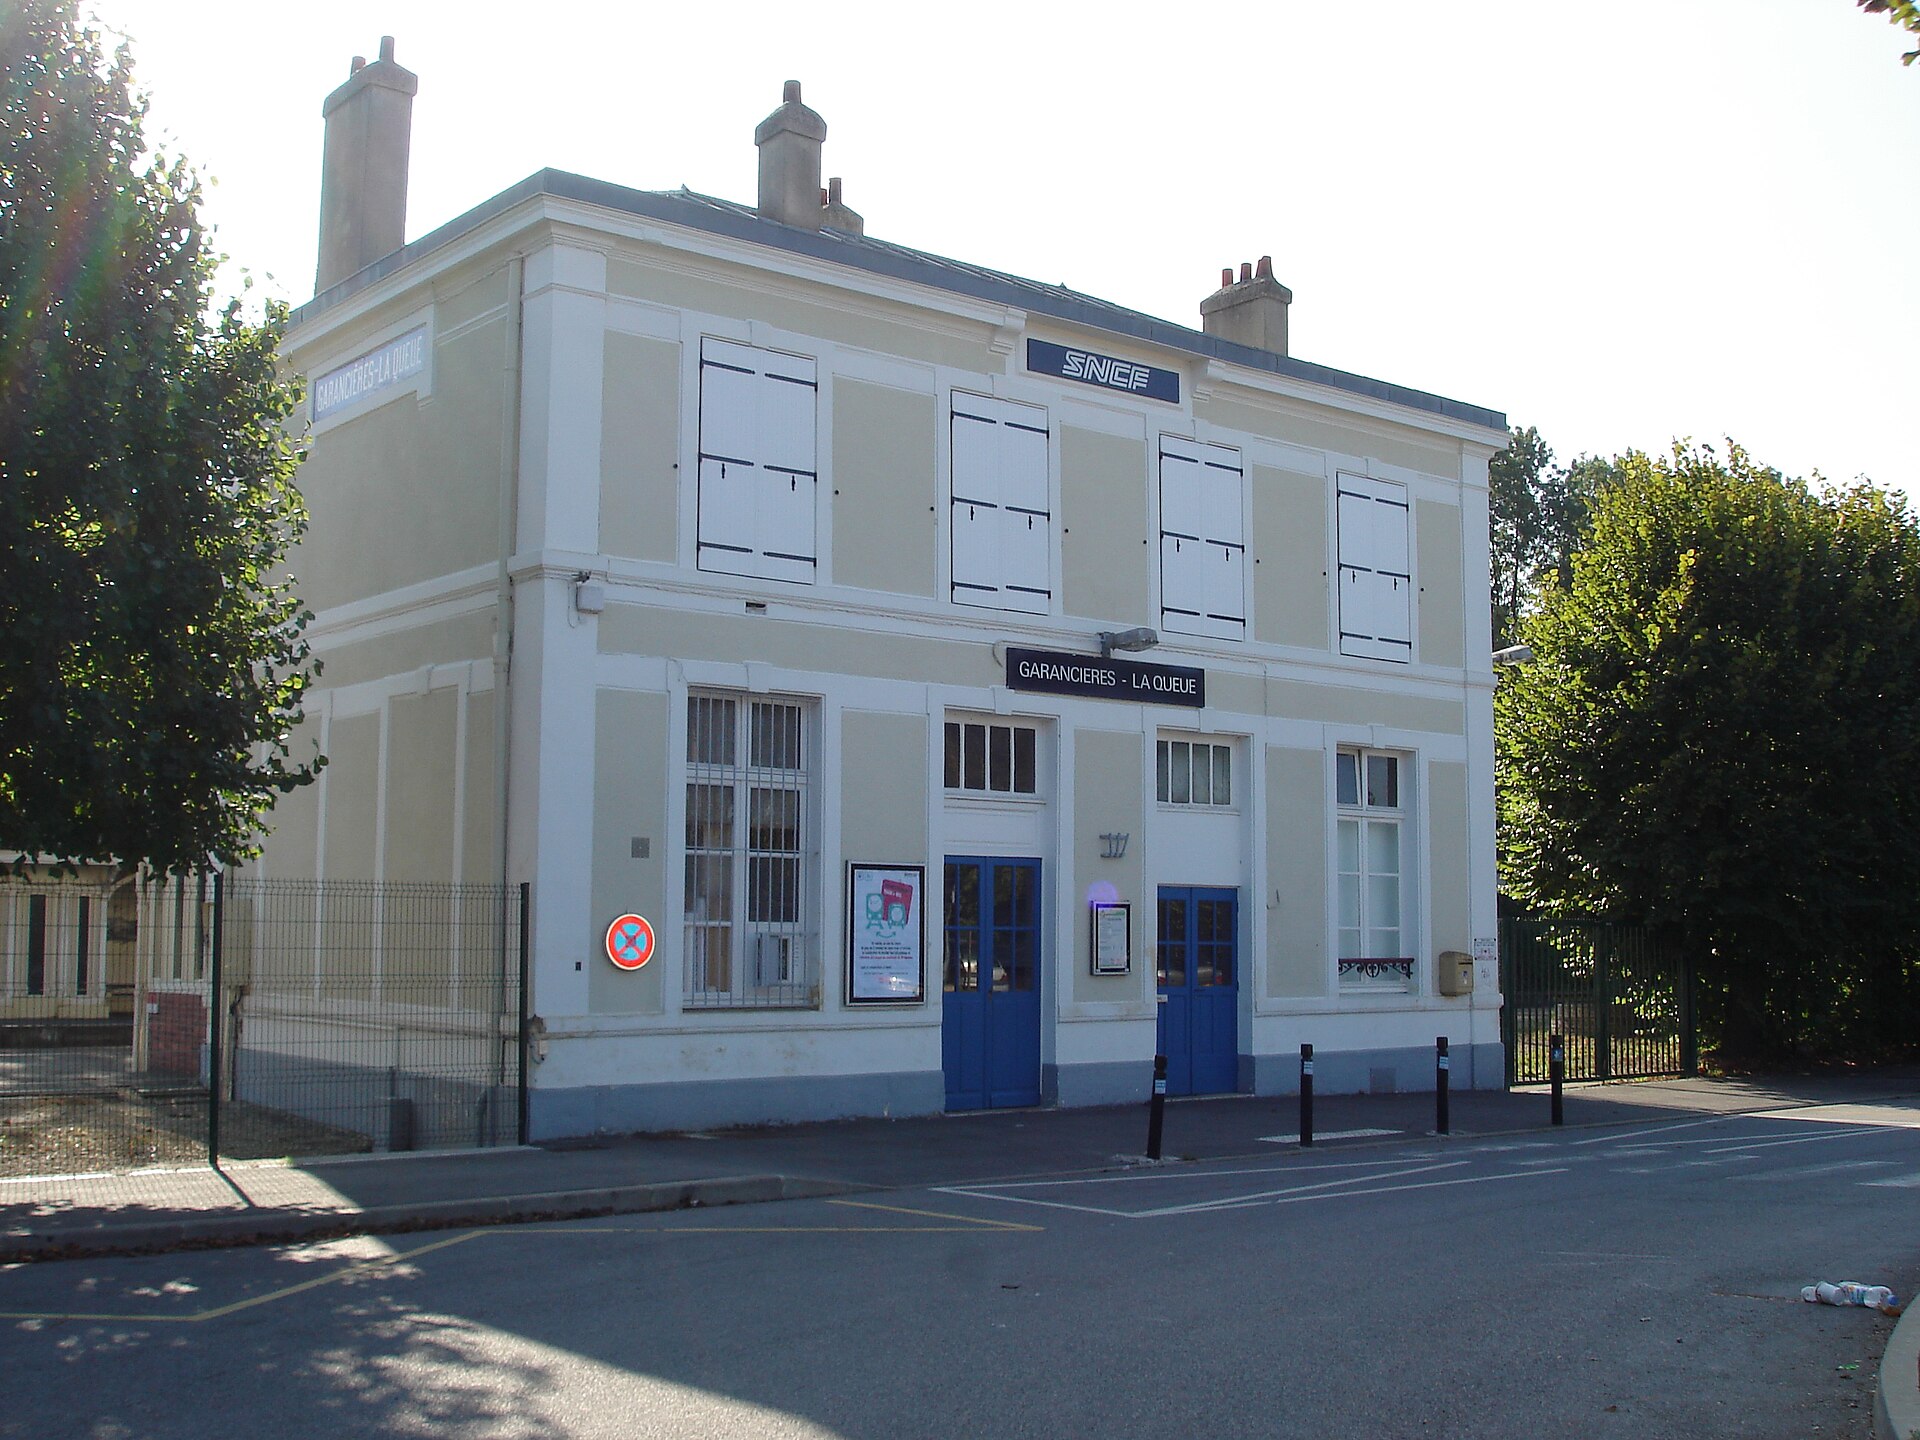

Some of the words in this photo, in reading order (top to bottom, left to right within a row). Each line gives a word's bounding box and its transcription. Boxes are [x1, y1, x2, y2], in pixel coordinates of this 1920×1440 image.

[392, 335, 422, 380] QUEUE
[1062, 350, 1150, 390] SNCF
[1019, 660, 1116, 686] GARANCIERES
[1132, 673, 1150, 689] LA
[1152, 675, 1197, 694] QUEUE
